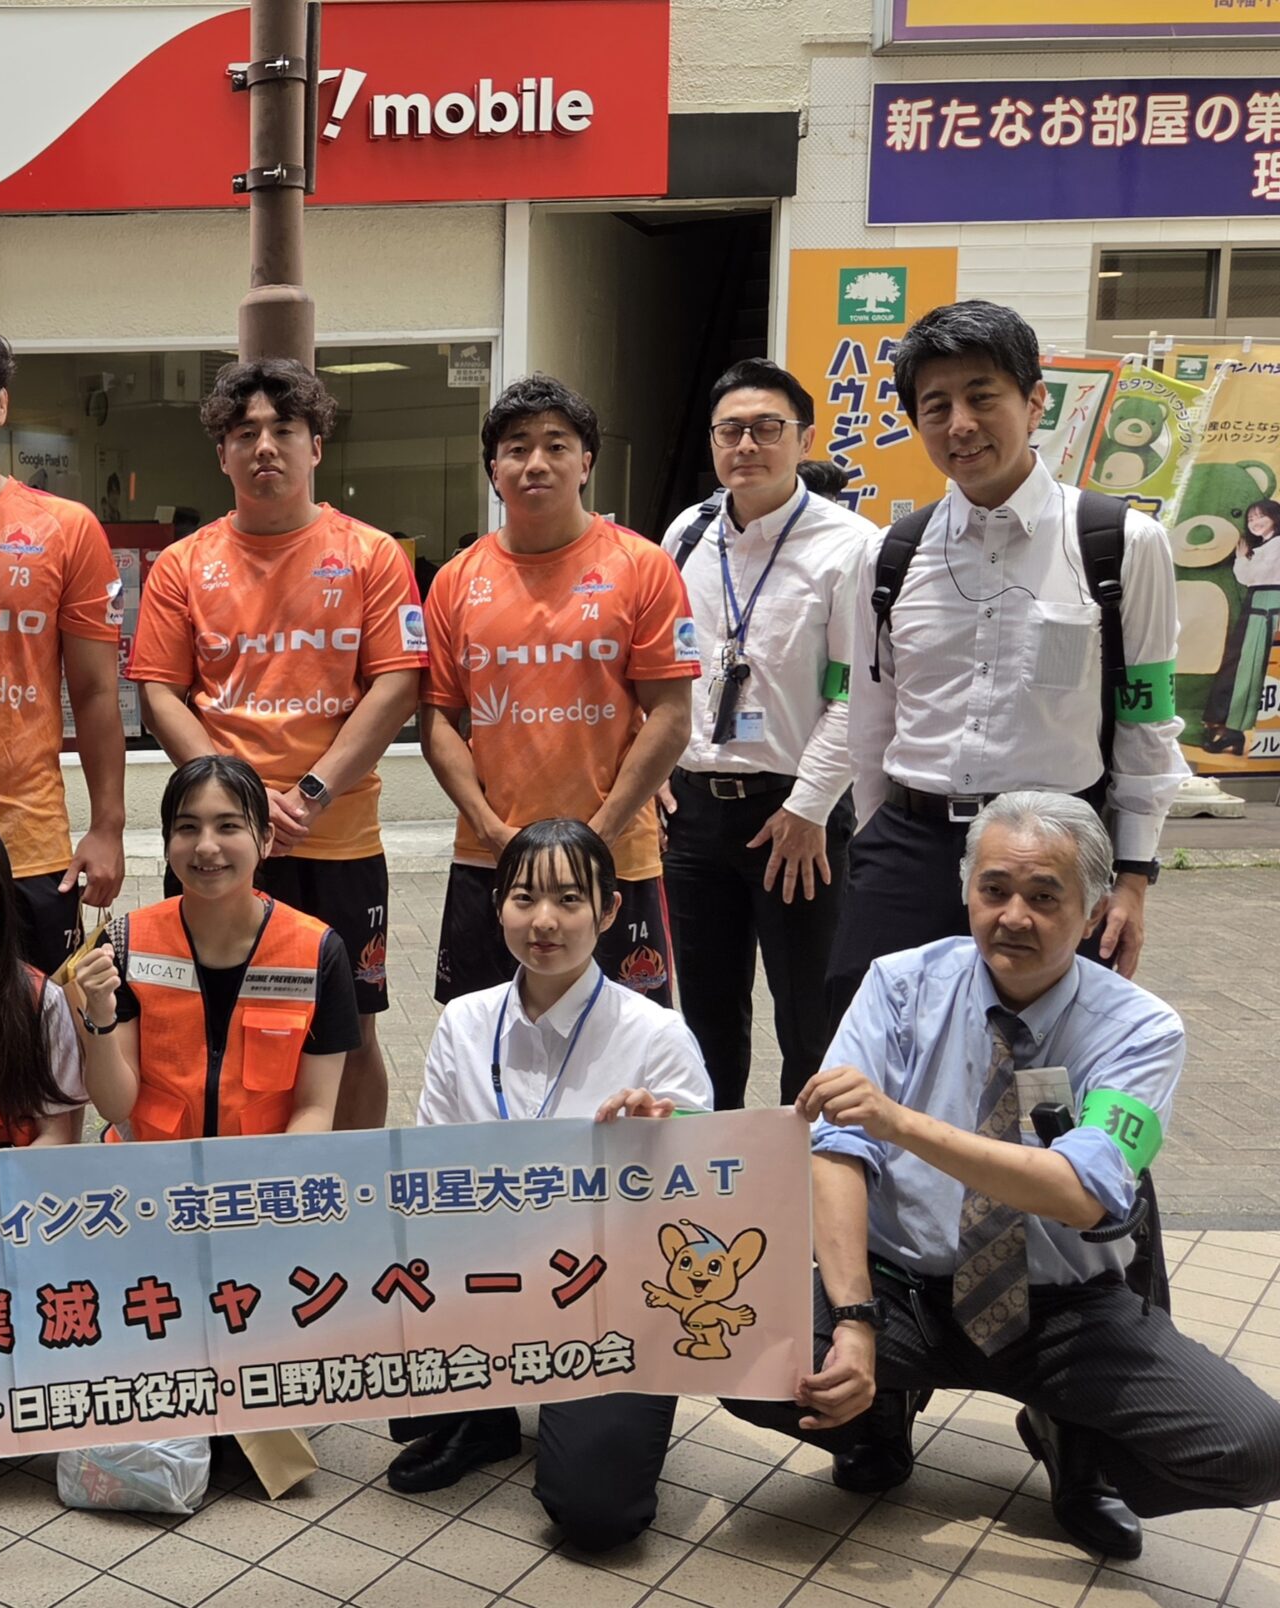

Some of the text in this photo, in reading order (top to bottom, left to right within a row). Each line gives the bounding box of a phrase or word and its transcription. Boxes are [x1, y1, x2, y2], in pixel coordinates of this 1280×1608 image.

[225, 63, 593, 140] !mobile
[886, 93, 1280, 151] 新たなお部屋の第
[18, 451, 44, 469] Google
[9, 566, 30, 587] 73
[322, 588, 343, 608] 77
[581, 602, 599, 621] 74
[237, 627, 361, 654] HINO
[497, 638, 619, 665] HINO
[244, 689, 355, 719] foredge
[510, 697, 616, 725] foredge
[367, 904, 384, 928] 77
[63, 929, 81, 949] 73
[628, 921, 650, 943] 74
[136, 961, 187, 980] MCAT
[245, 974, 314, 985] CRIME PREVENTION
[1104, 1103, 1144, 1150] 犯
